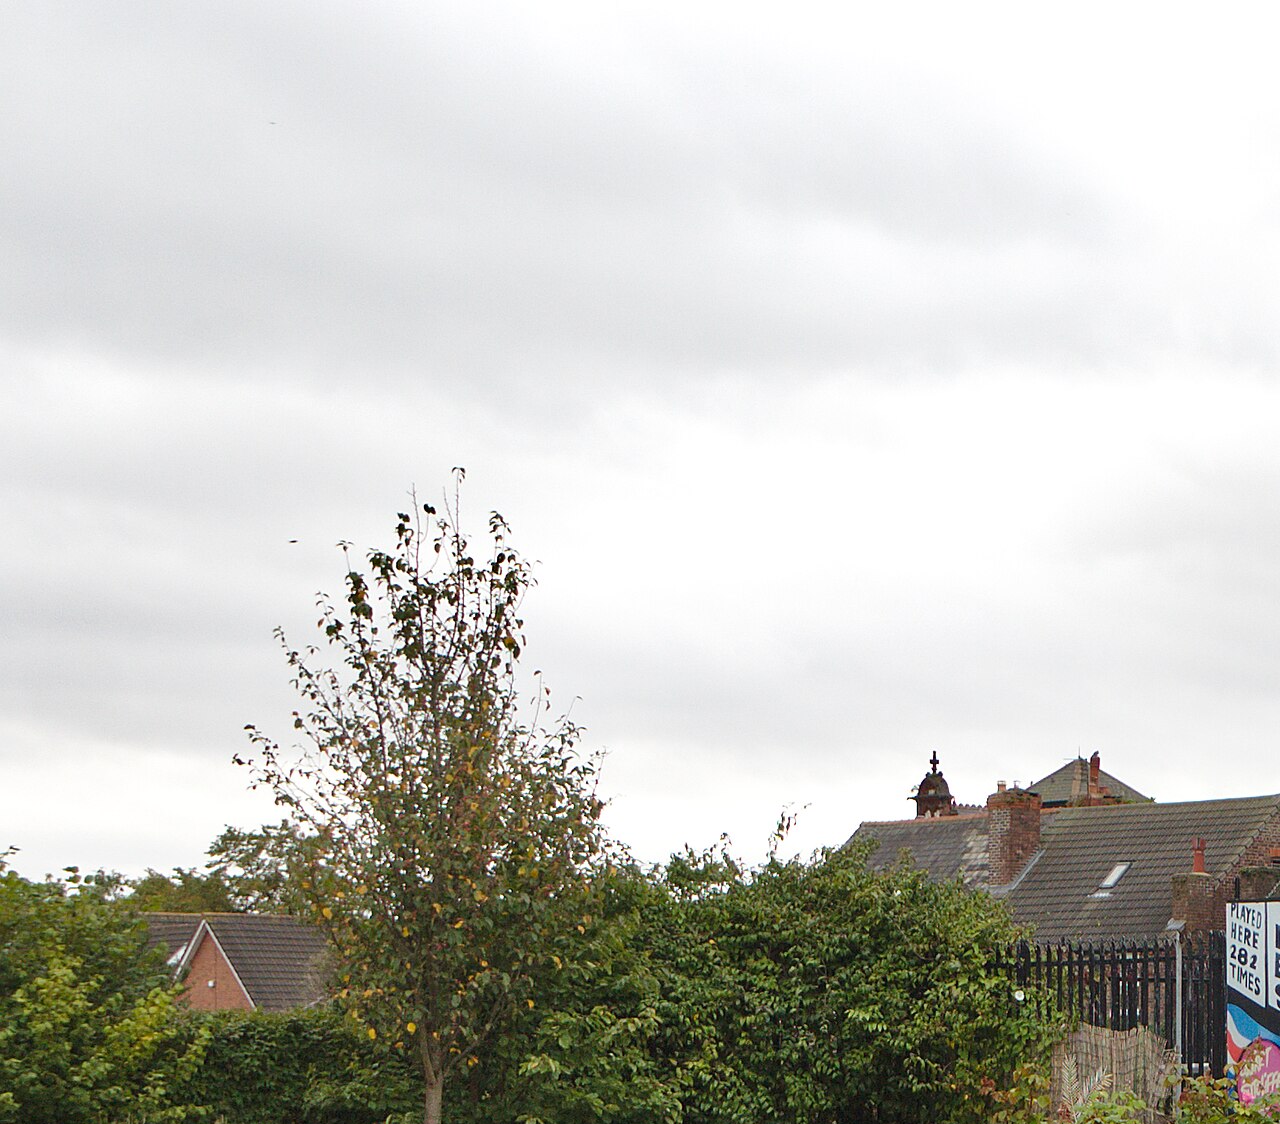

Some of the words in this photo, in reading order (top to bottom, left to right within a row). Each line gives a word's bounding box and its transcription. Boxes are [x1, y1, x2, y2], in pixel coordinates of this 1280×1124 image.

[1230, 902, 1262, 930] PLAYED
[1230, 921, 1260, 950] HERE
[1230, 944, 1258, 970] 282
[1229, 962, 1261, 996] TIMES
